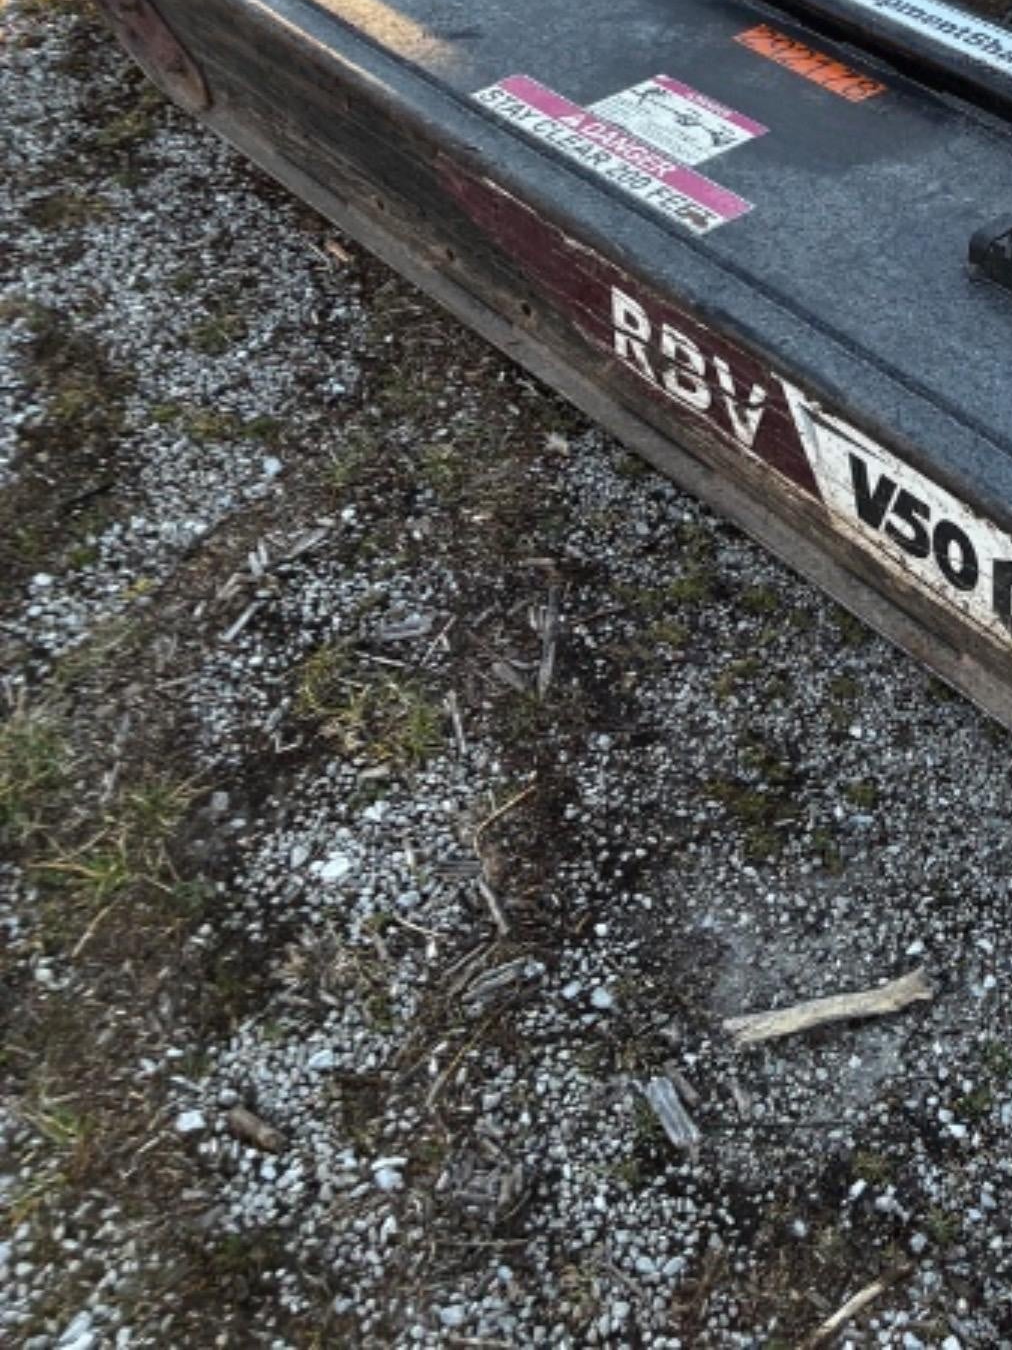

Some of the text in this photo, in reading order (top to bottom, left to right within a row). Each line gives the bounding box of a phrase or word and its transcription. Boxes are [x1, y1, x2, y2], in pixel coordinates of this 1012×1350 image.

[479, 89, 541, 120] STAY
[533, 119, 612, 165] CLEAR
[605, 165, 651, 189] 200
[579, 122, 677, 177] DANGER
[611, 285, 766, 447] RBV
[848, 452, 979, 592] V50
